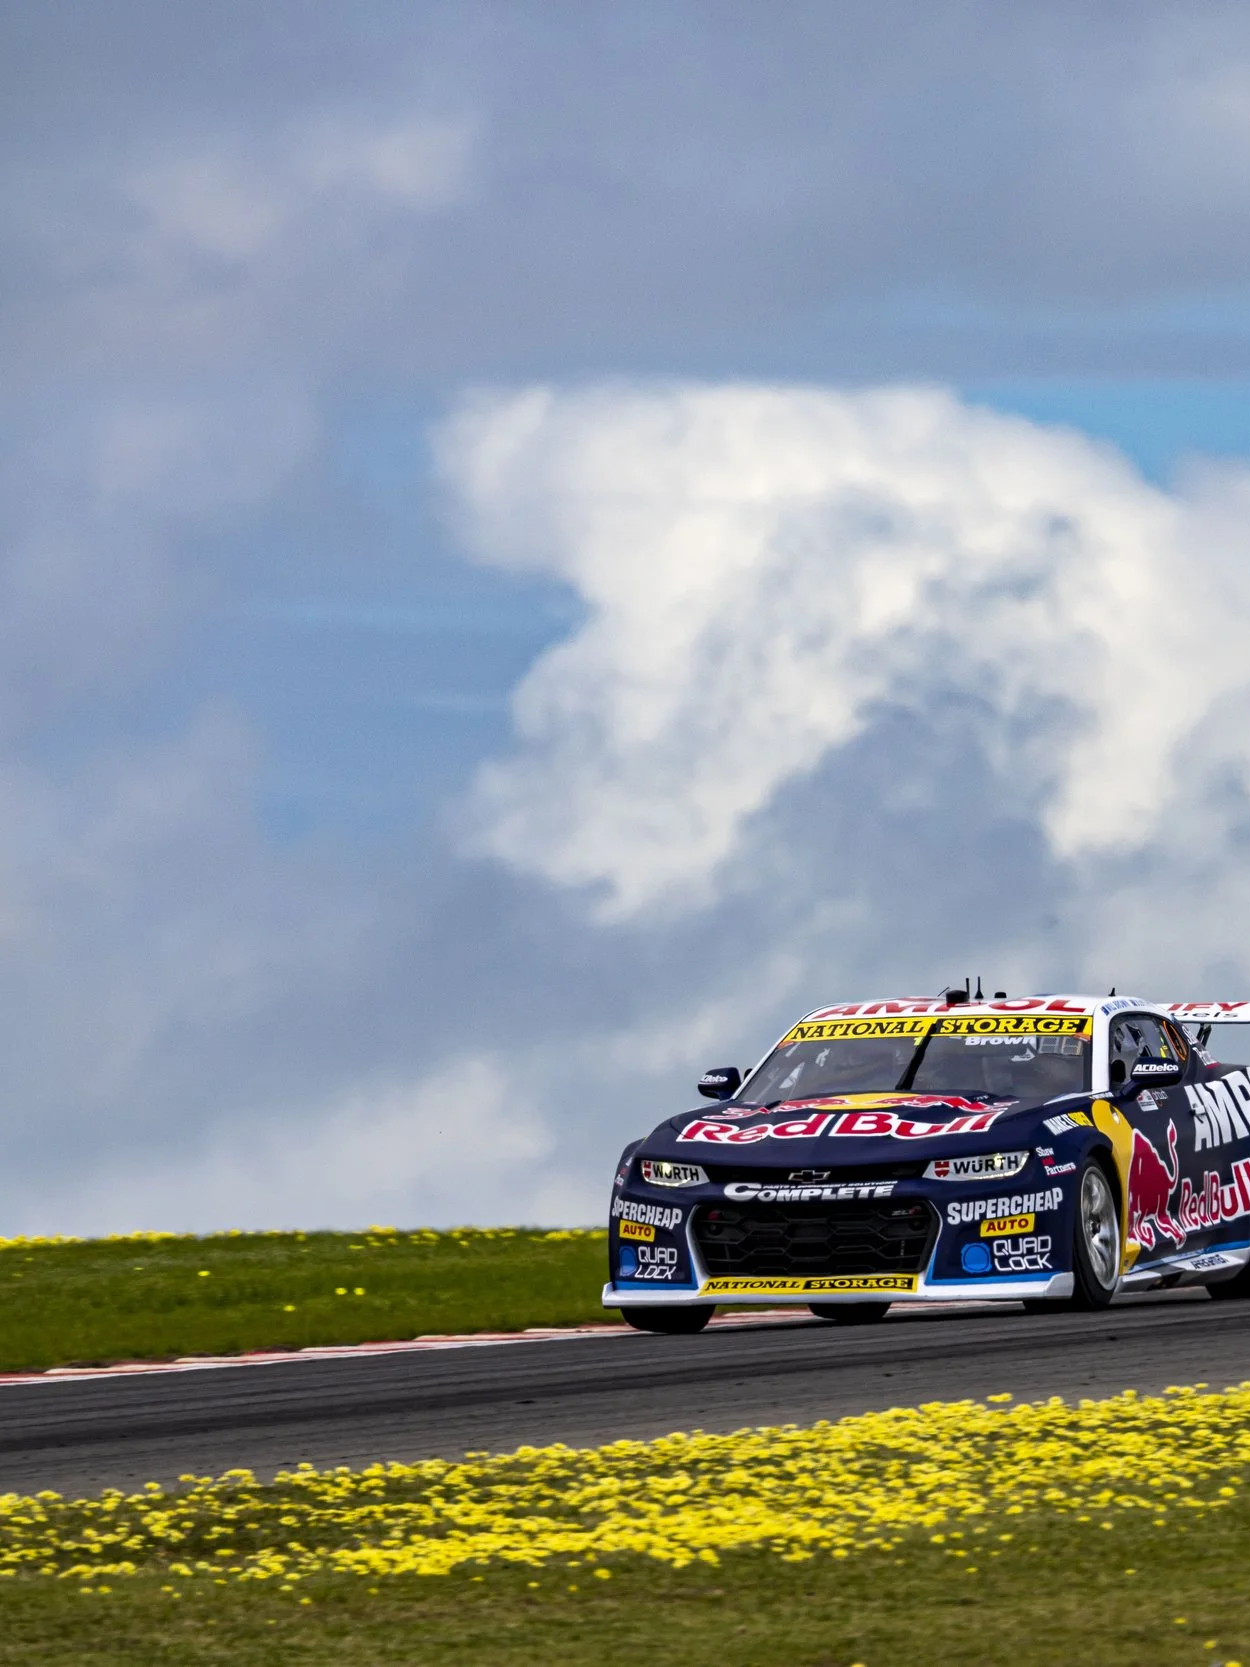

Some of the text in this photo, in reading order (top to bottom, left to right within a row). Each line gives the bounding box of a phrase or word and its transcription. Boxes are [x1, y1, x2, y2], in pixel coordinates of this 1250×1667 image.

[813, 997, 1087, 1019] AMPOL
[1168, 1001, 1250, 1012] IFY
[791, 1018, 1081, 1041] NATIONAL STORAGE
[965, 1036, 1034, 1046] Brown
[1133, 1063, 1180, 1072] ACDelco
[678, 1109, 1006, 1144] Red Bull
[953, 1155, 1019, 1175] WÜRTH
[1044, 1161, 1077, 1176] Partners
[723, 1182, 895, 1202] COMPLETE
[947, 1187, 1063, 1225] SUPERCHEAP
[1179, 1171, 1209, 1233] Red
[623, 1224, 652, 1237] AUTO
[985, 1218, 1029, 1232] AUTO
[993, 1235, 1051, 1256] QUAD
[638, 1246, 677, 1264] QUAD
[994, 1253, 1053, 1271] LOCK
[634, 1265, 676, 1279] LOCK
[705, 1277, 909, 1291] NATIONAL STORAGE
